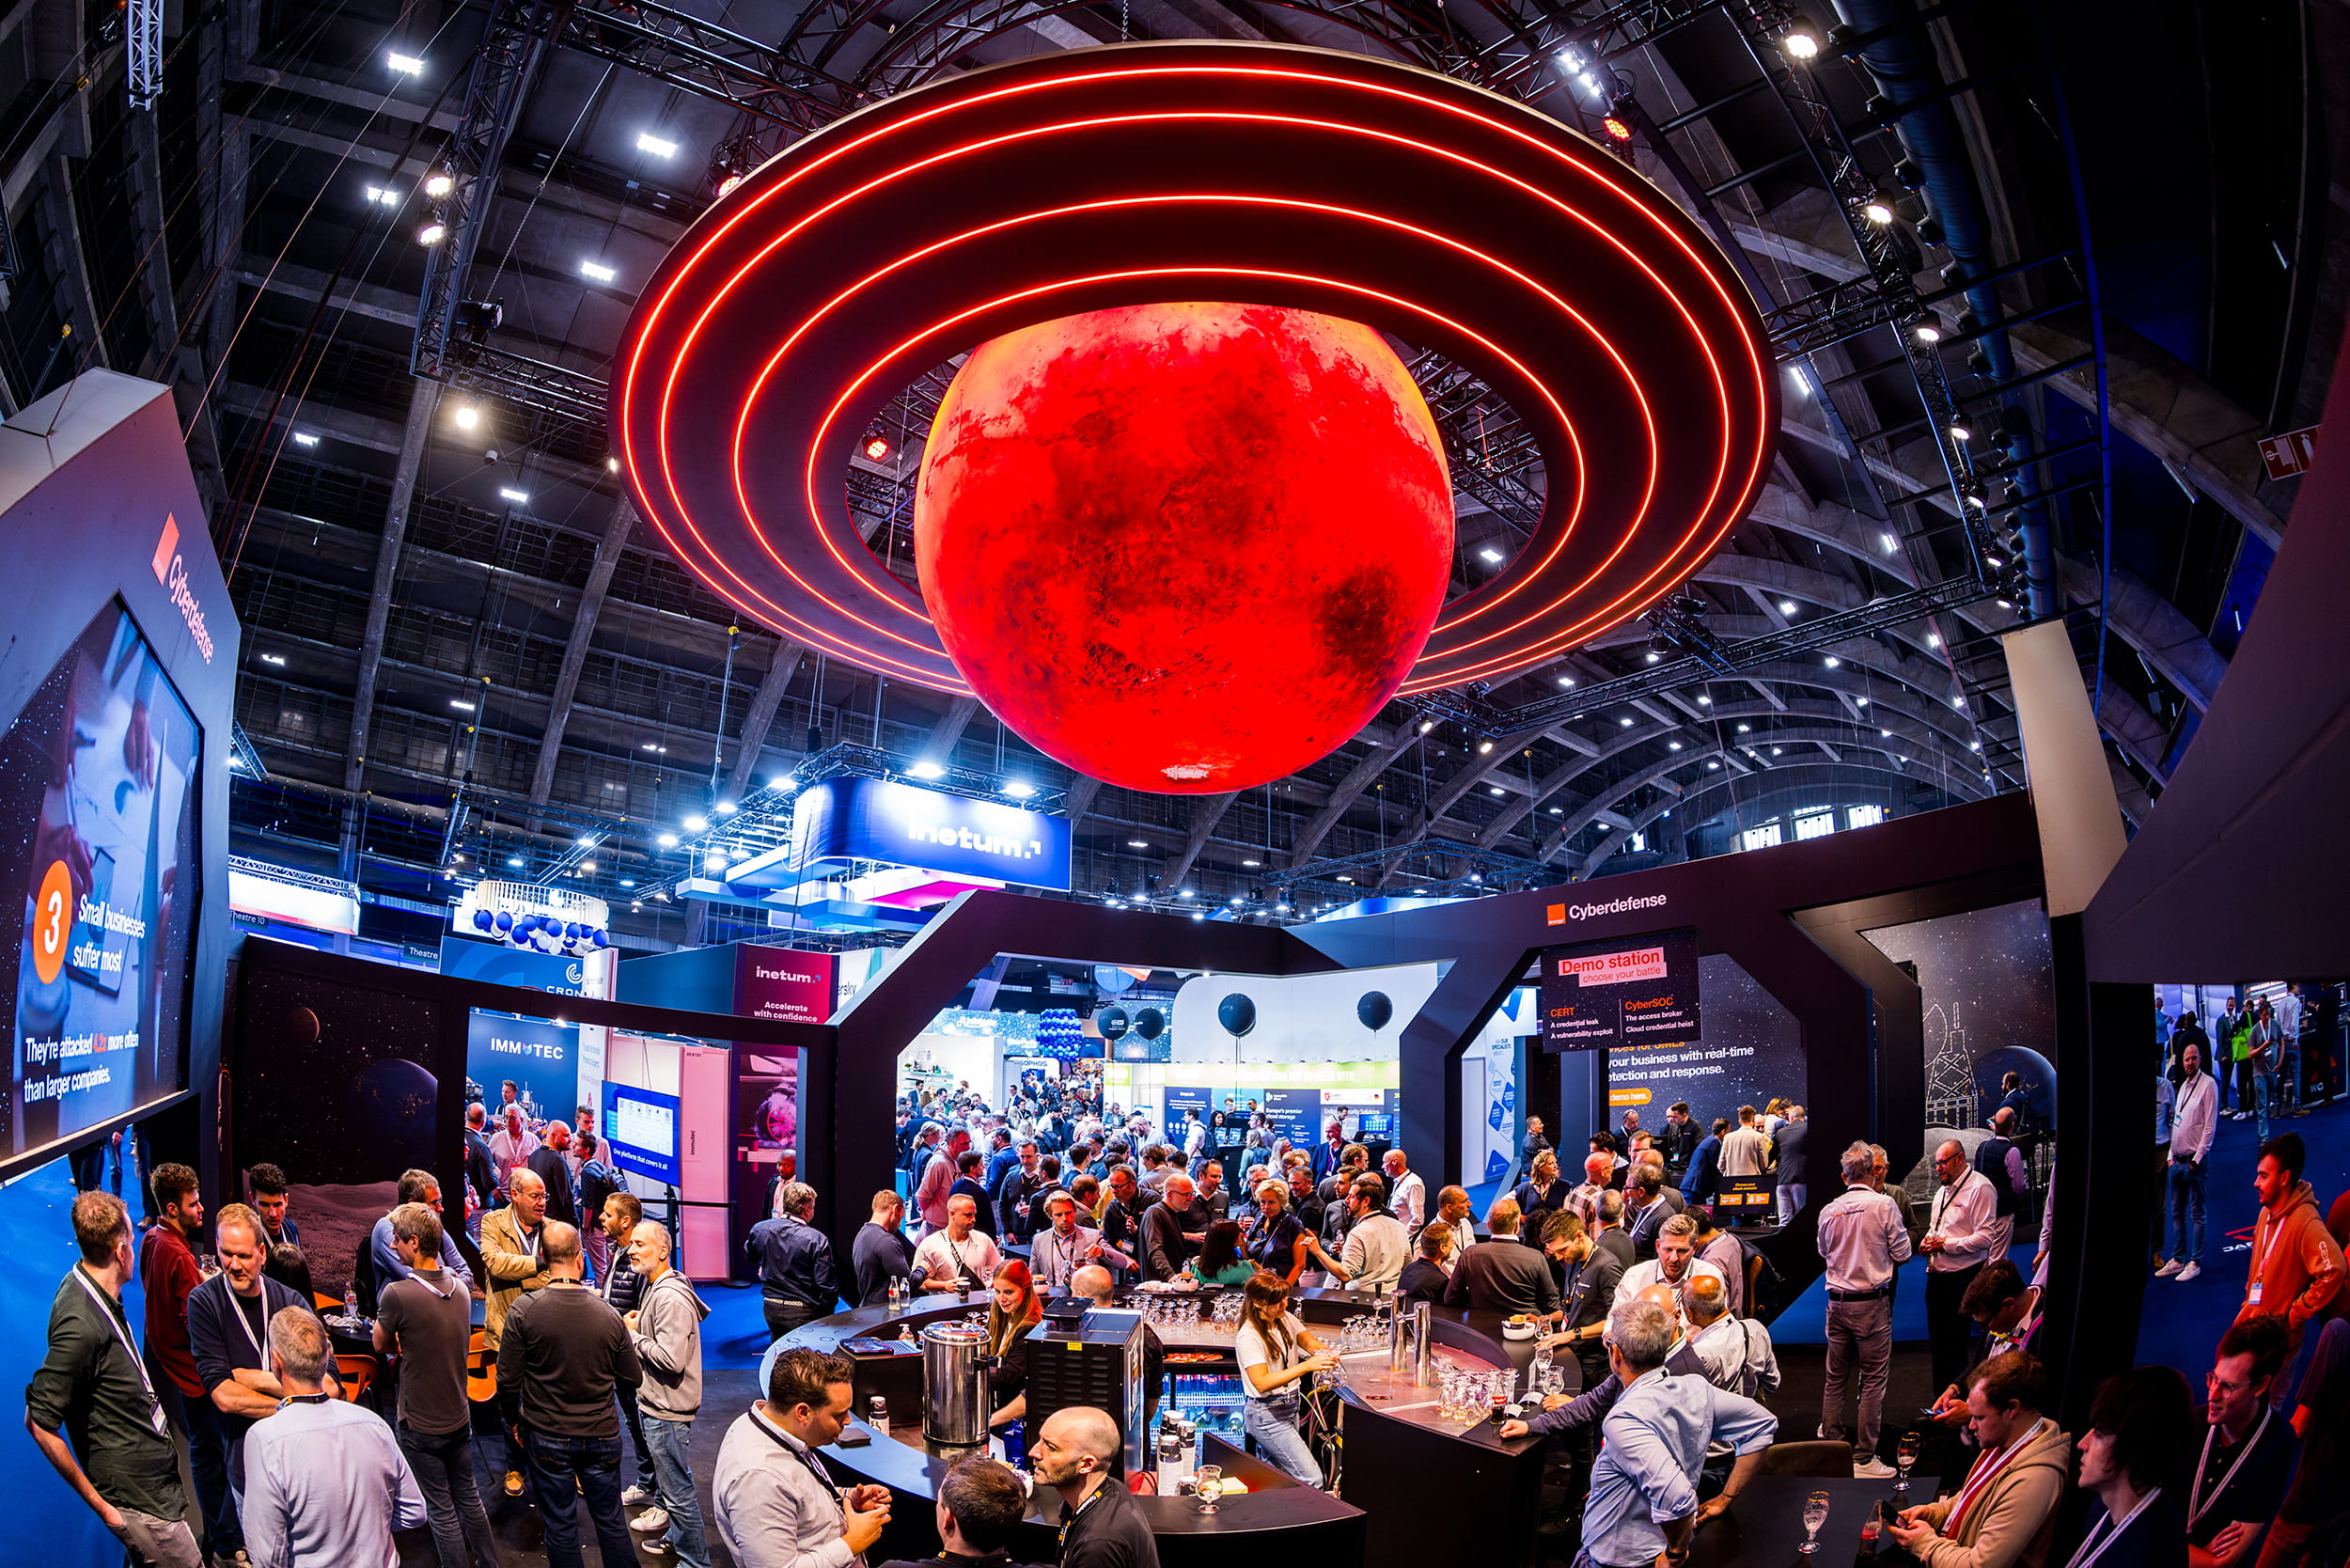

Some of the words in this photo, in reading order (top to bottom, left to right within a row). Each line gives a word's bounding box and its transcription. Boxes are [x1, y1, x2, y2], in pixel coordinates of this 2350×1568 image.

[169, 555, 213, 665] Cyberdefense
[79, 893, 105, 927] Small
[104, 903, 146, 939] businesses
[1569, 894, 1668, 920] Cyberdefense
[44, 890, 62, 954] 3
[73, 941, 101, 969] suffer
[101, 949, 122, 972] most
[409, 947, 438, 959] Theatre
[1562, 960, 1604, 974] Demo
[1608, 951, 1660, 968] station
[1583, 972, 1613, 983] choose
[1616, 970, 1634, 981] your
[1637, 965, 1661, 976] battle
[764, 1001, 808, 1012] Accelerate
[1550, 1007, 1575, 1017] CERT
[1624, 996, 1674, 1011] CyberSOC
[754, 1010, 772, 1018] with
[774, 1011, 818, 1023] confidence
[1662, 1010, 1683, 1018] broker
[1556, 1019, 1586, 1028] credential
[1646, 1022, 1677, 1031] credential
[1678, 1020, 1694, 1028] heist
[1557, 1029, 1592, 1039] vulnerability
[1592, 1027, 1613, 1037] exploit
[25, 1036, 58, 1066] They're
[59, 1033, 93, 1058] attacked
[107, 1035, 123, 1051] more
[124, 1029, 139, 1048] often
[1631, 1053, 1678, 1066] business
[1680, 1050, 1702, 1061] with
[1705, 1045, 1755, 1059] real-time
[1649, 1068, 1669, 1079] and
[1671, 1064, 1725, 1080] response.
[24, 1077, 44, 1103] than
[46, 1074, 70, 1100] larger
[71, 1064, 111, 1092] companies.
[613, 1148, 621, 1156] One
[620, 1150, 637, 1161] platform
[636, 1154, 646, 1164] that
[646, 1159, 658, 1168] covers
